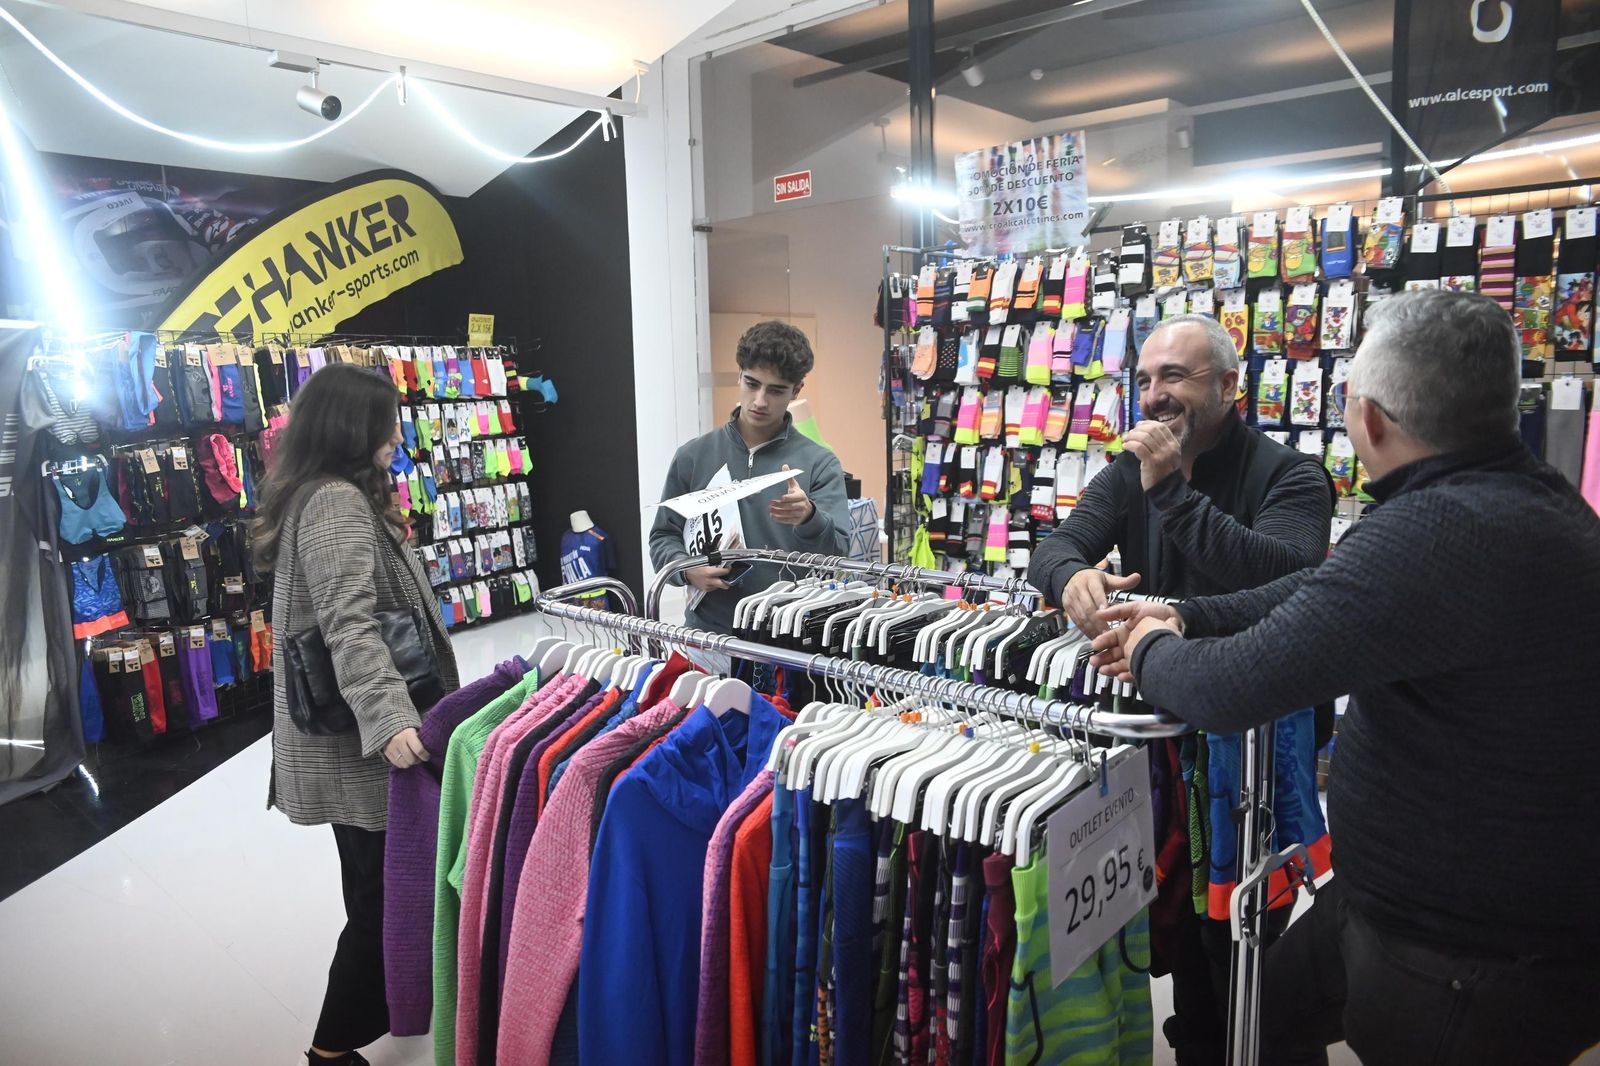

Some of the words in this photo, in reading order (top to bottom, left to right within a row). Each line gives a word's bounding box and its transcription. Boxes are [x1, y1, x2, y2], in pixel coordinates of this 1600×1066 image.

[1028, 161, 1044, 172] DE
[787, 177, 810, 193] SALIDA
[991, 182, 1004, 193] DE
[1007, 171, 1074, 191] DESCUENTO
[993, 194, 1048, 216] 2X10€
[243, 194, 417, 324] HANKER
[1069, 812, 1102, 849] OUTLET
[1104, 787, 1134, 825] EVENTO
[1065, 844, 1132, 935] 29,95
[1137, 847, 1145, 872] €
